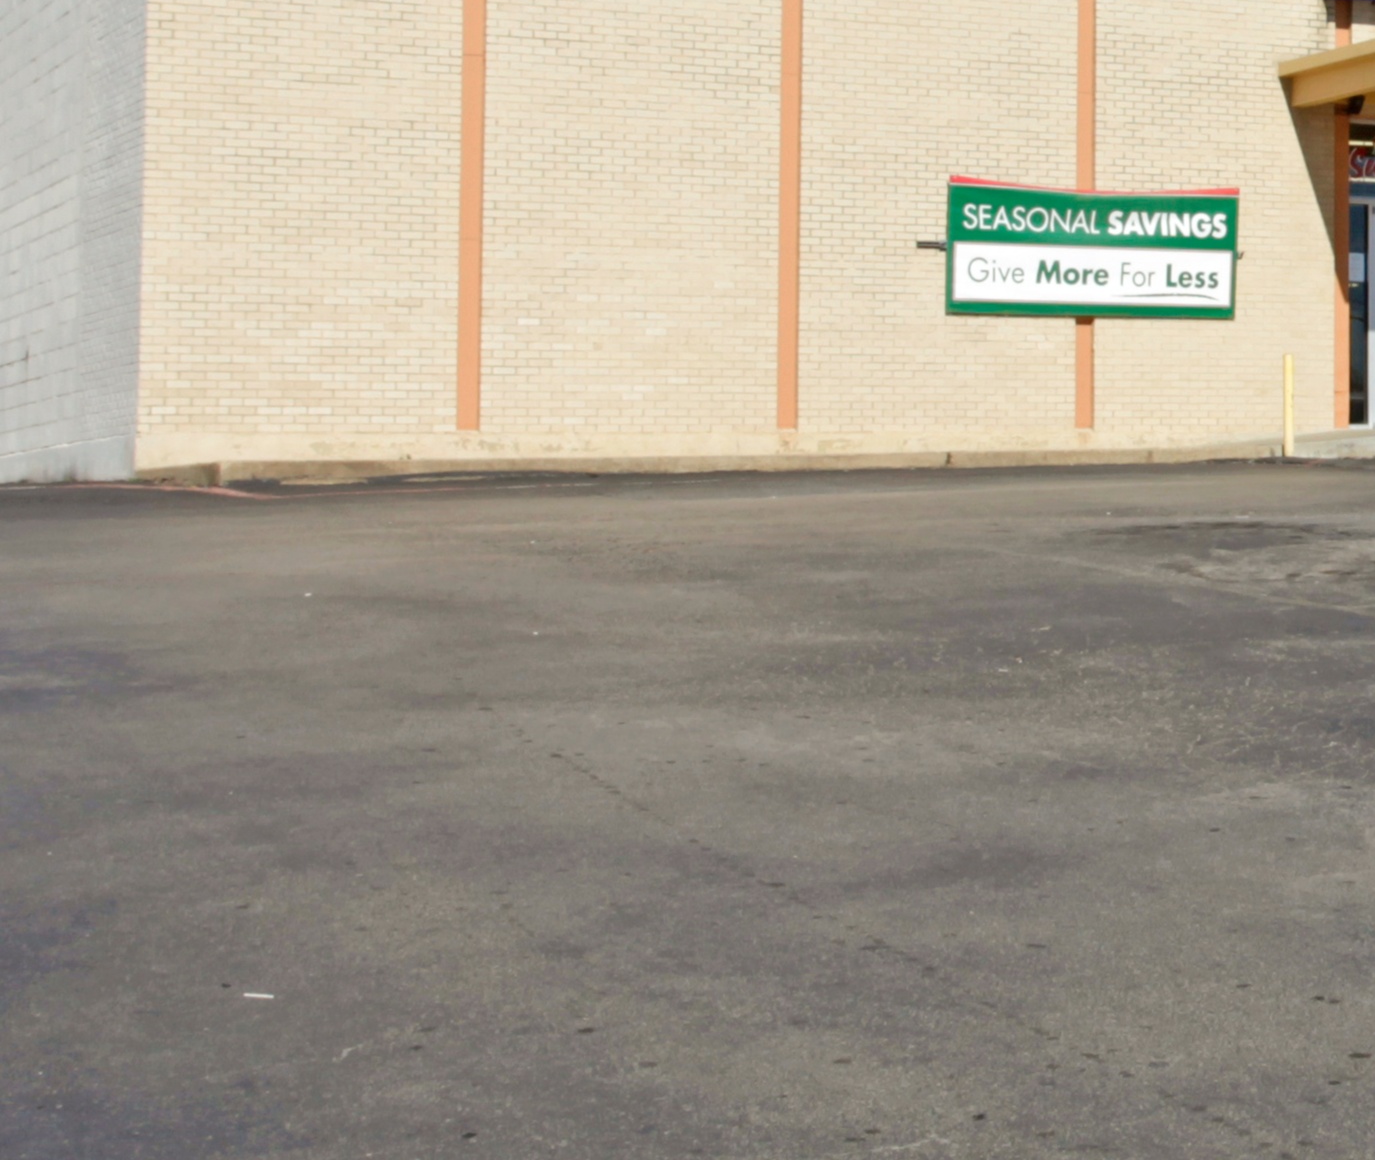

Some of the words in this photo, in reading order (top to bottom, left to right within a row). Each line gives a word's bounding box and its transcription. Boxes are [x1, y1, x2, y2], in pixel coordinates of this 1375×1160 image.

[962, 203, 1100, 235] SEASONAL
[1107, 210, 1228, 239] SAVINGS
[967, 256, 1025, 285] Give
[1035, 260, 1109, 286] More
[1120, 262, 1156, 287] For
[1165, 263, 1219, 289] Less
